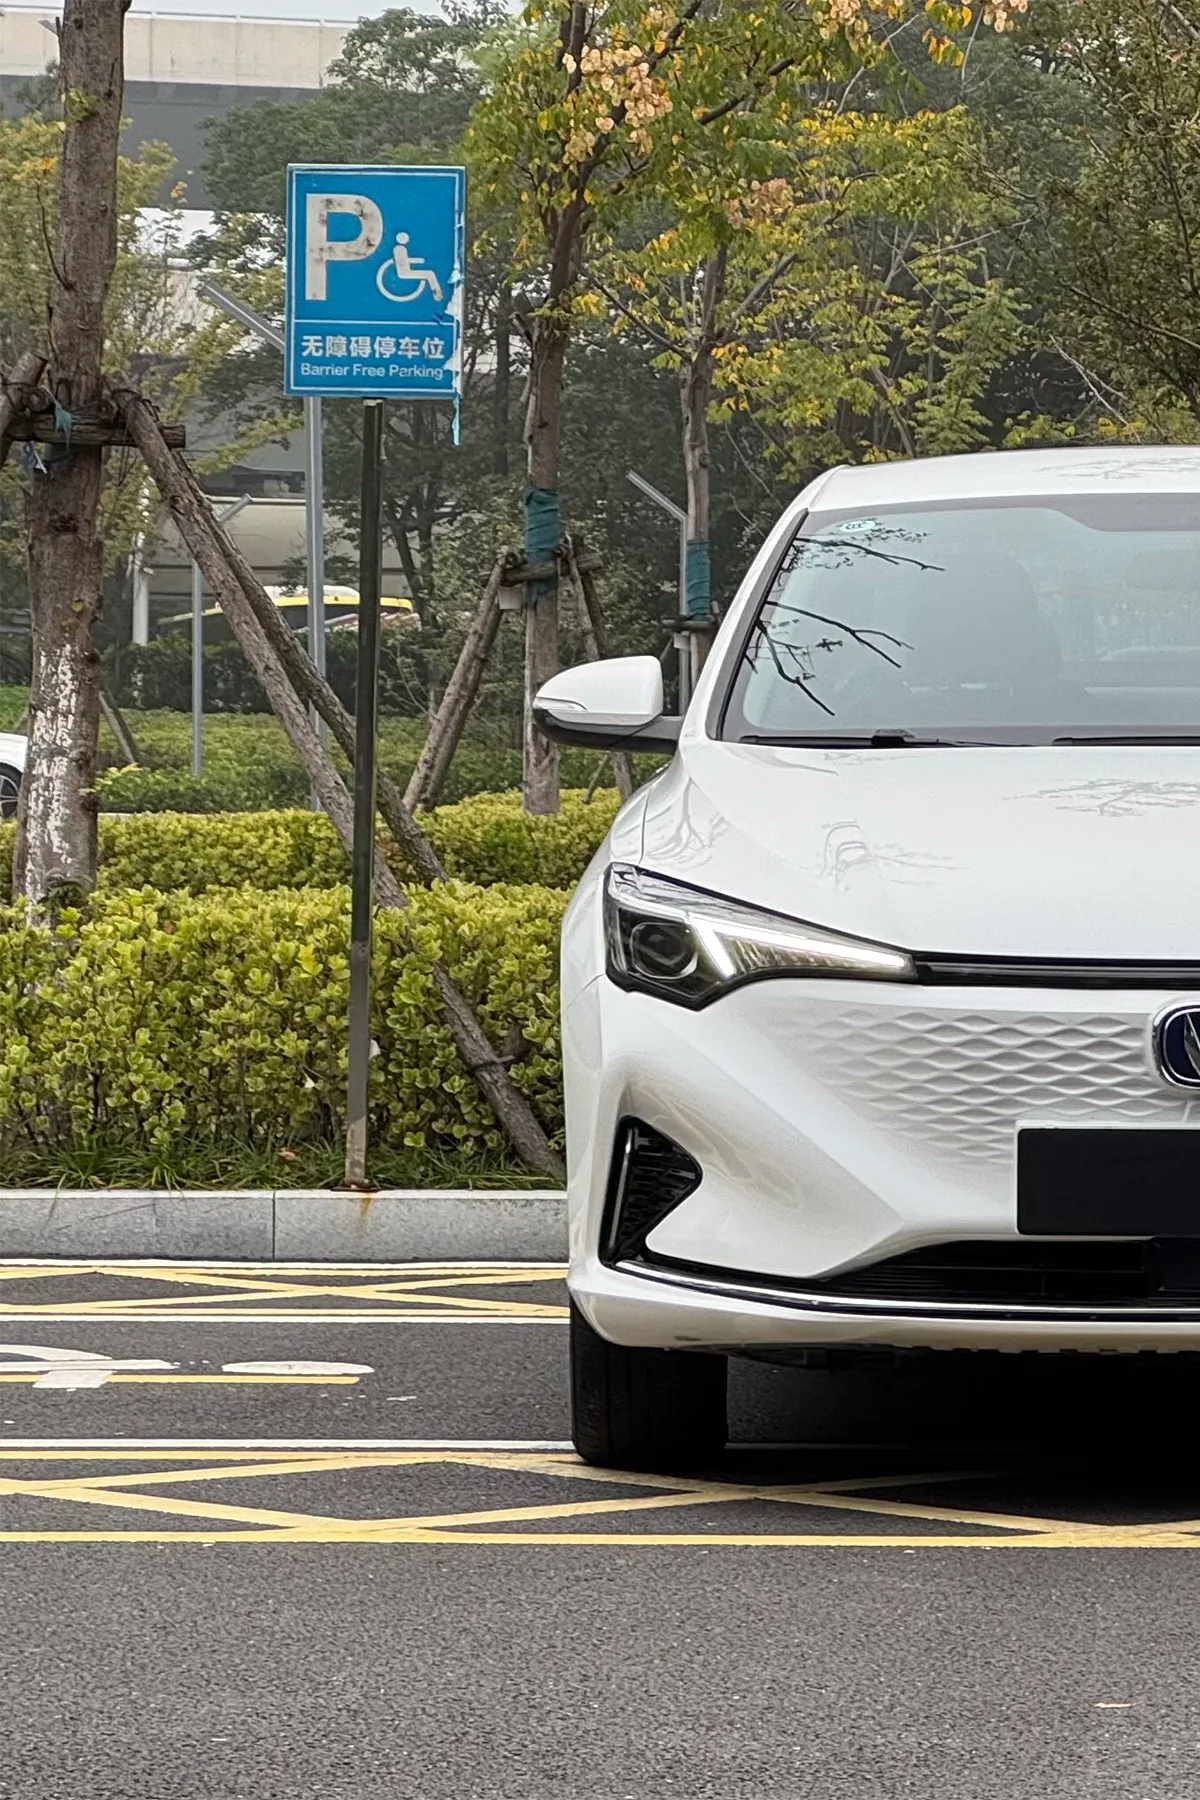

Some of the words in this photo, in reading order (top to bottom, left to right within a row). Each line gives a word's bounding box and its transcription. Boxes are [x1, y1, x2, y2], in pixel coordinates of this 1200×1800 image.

[305, 193, 383, 300] P
[301, 335, 445, 359] 无障碍停车位
[301, 363, 349, 376] Barrier
[353, 364, 385, 377] Free
[389, 364, 443, 380] Parking
